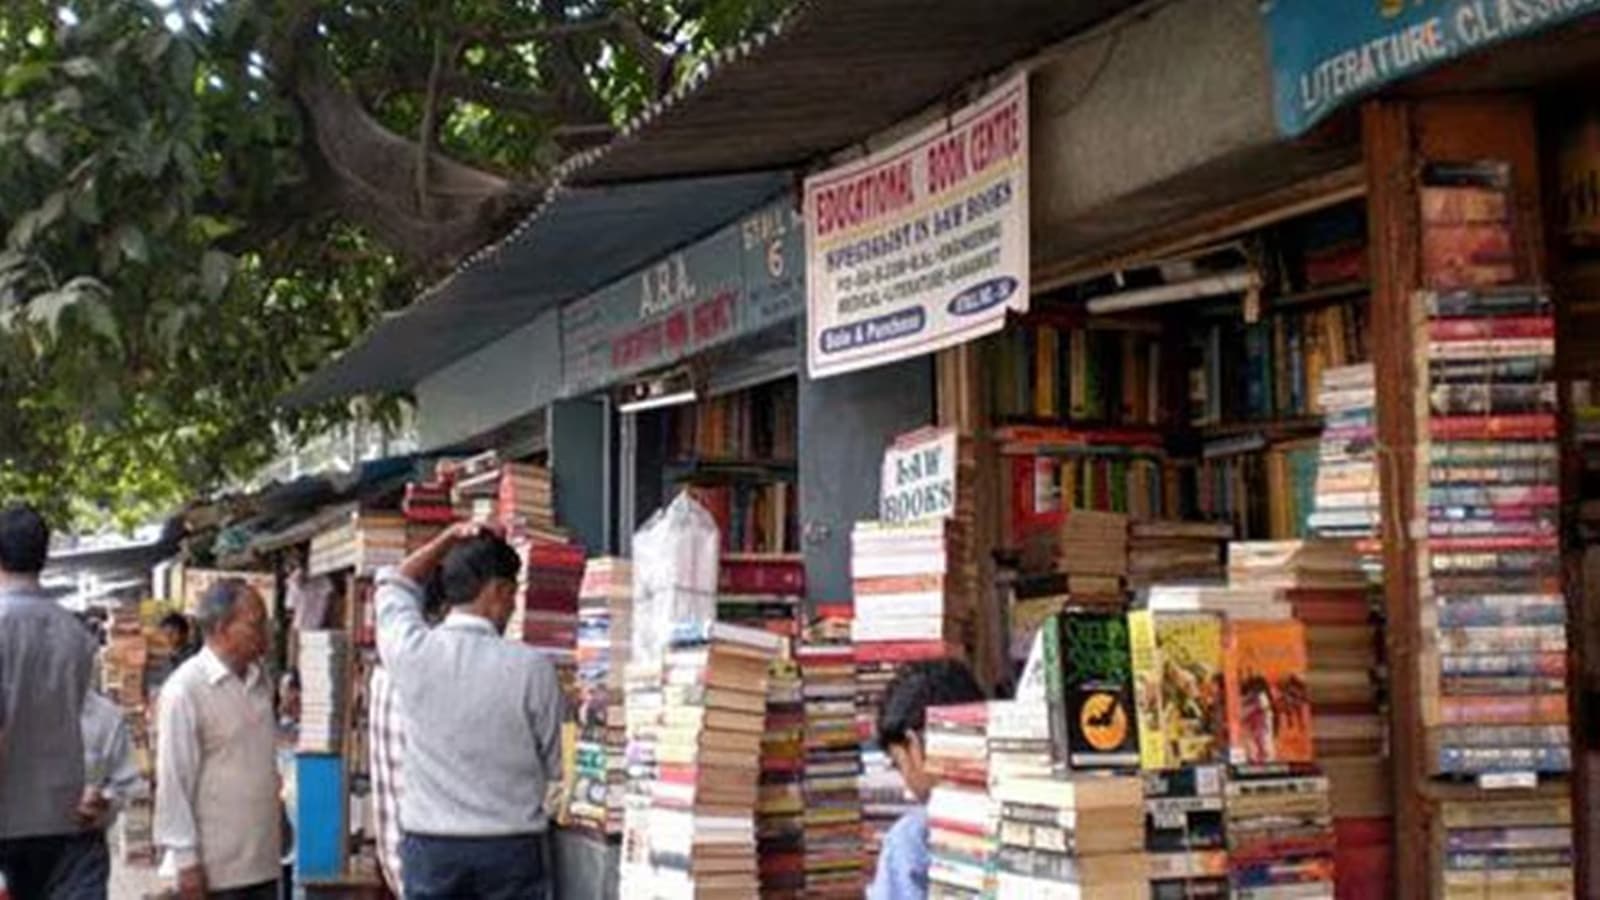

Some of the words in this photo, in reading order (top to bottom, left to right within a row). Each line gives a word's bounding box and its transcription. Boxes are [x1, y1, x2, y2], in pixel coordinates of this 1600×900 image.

[816, 158, 916, 236] EDUCATIONAL
[927, 130, 968, 195] BOOK
[970, 101, 1020, 175] CENTRE
[767, 238, 785, 277] 6
[885, 480, 952, 521] BOOKS
